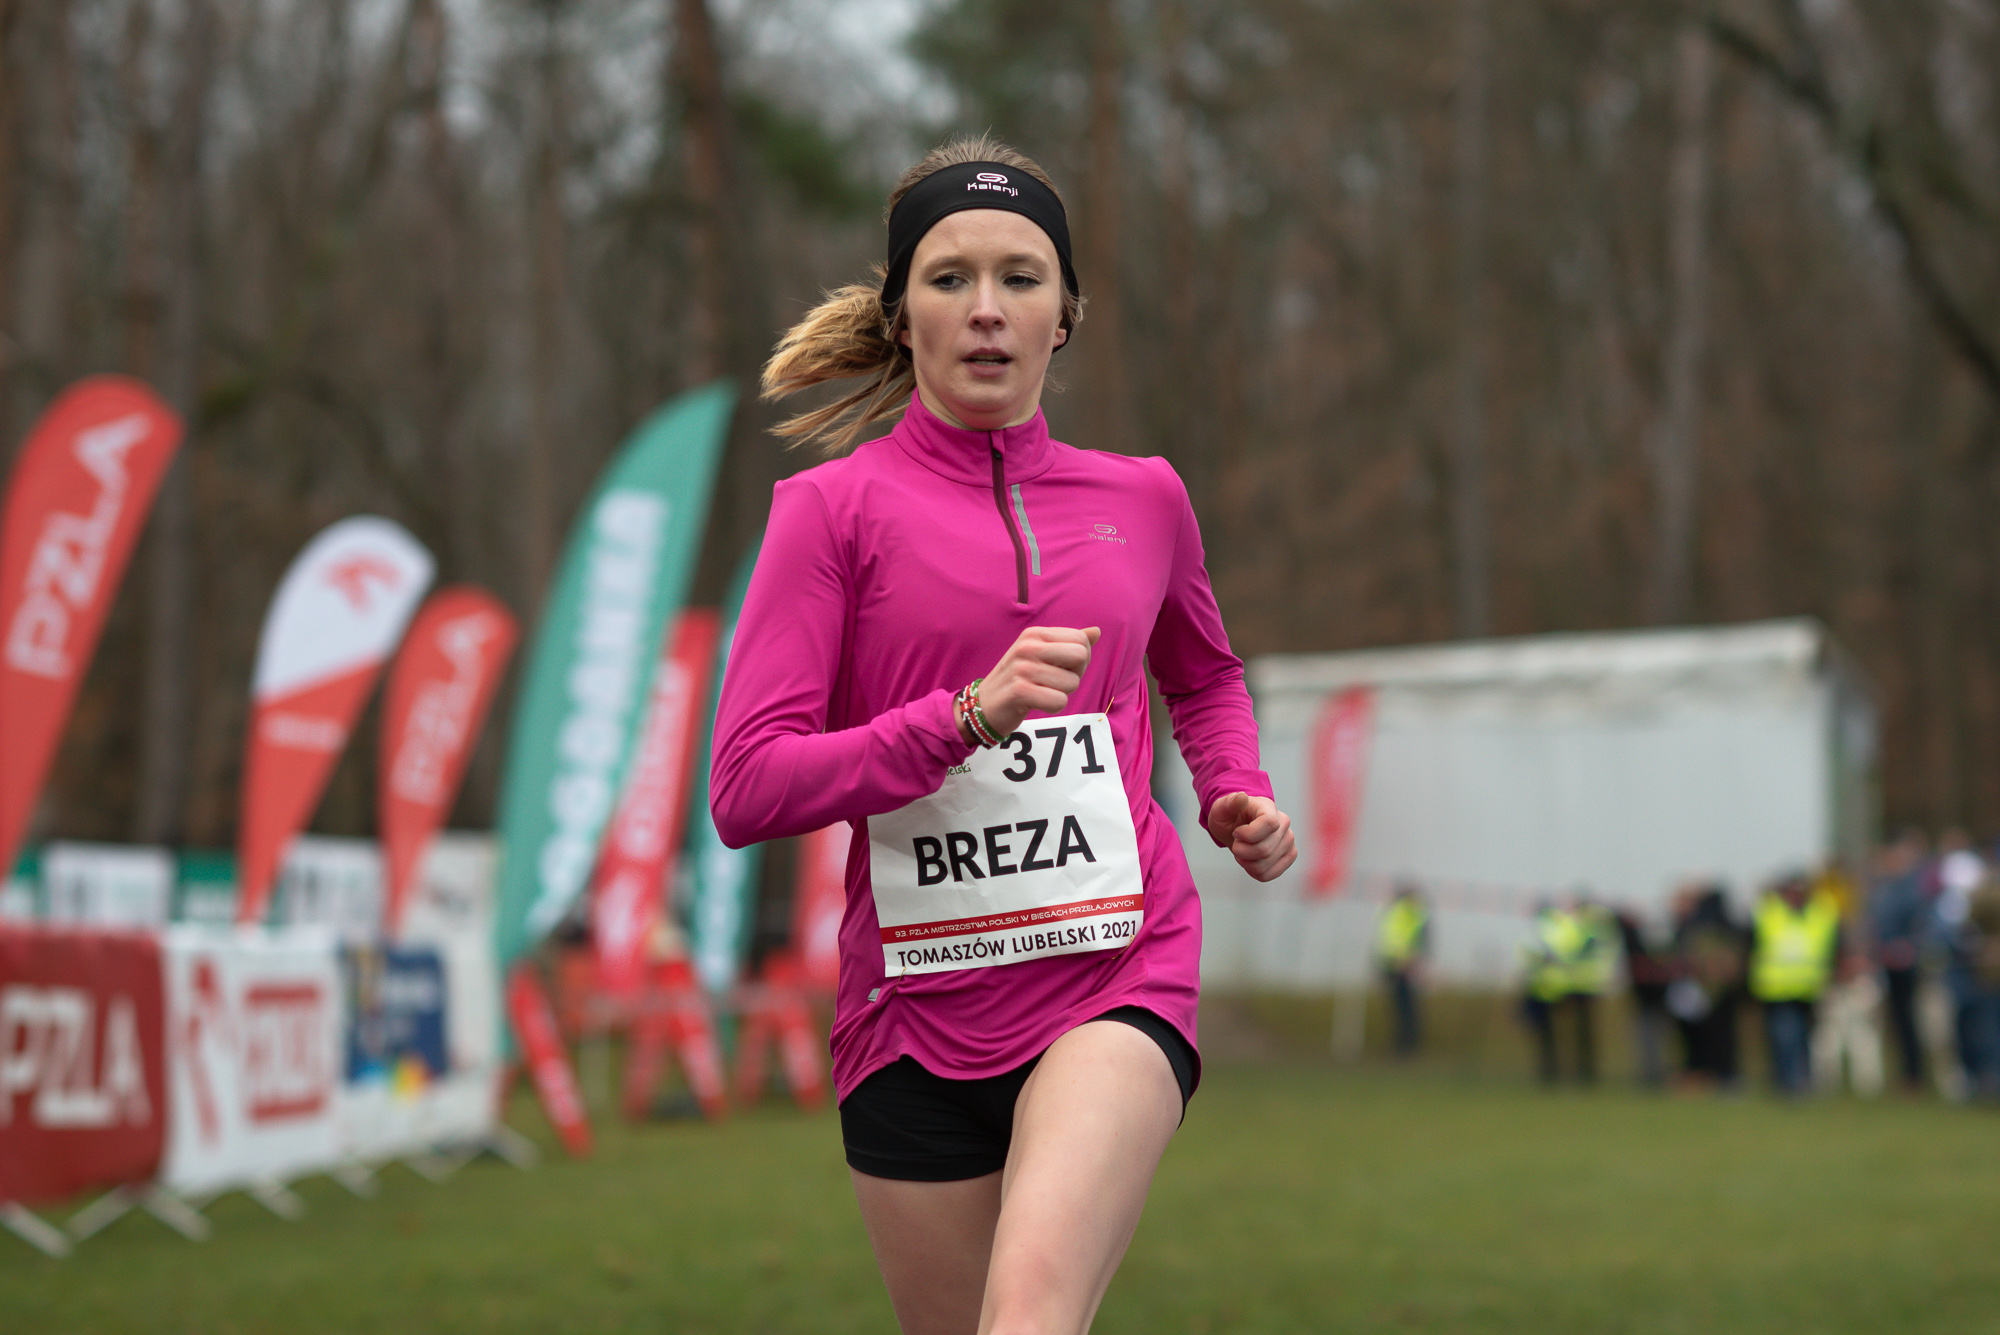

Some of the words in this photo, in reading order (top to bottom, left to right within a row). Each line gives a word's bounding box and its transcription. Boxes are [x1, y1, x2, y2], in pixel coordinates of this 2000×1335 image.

[967, 182, 1019, 197] Kalenji
[5, 411, 154, 680] PZLA
[1088, 532, 1127, 546] Kalenji
[1000, 725, 1105, 782] 371
[912, 814, 1097, 887] BREZA
[897, 936, 1005, 967] TOMASZÓW
[1011, 925, 1097, 954] LUBELSKI
[1101, 920, 1136, 940] 2021
[909, 927, 930, 937] PZLA
[930, 920, 988, 934] MISTRZOSTWA
[988, 915, 1020, 927] POLSKI
[1020, 914, 1030, 922] W
[1030, 908, 1068, 921] BIEGACH
[0, 983, 153, 1130] PZLA
